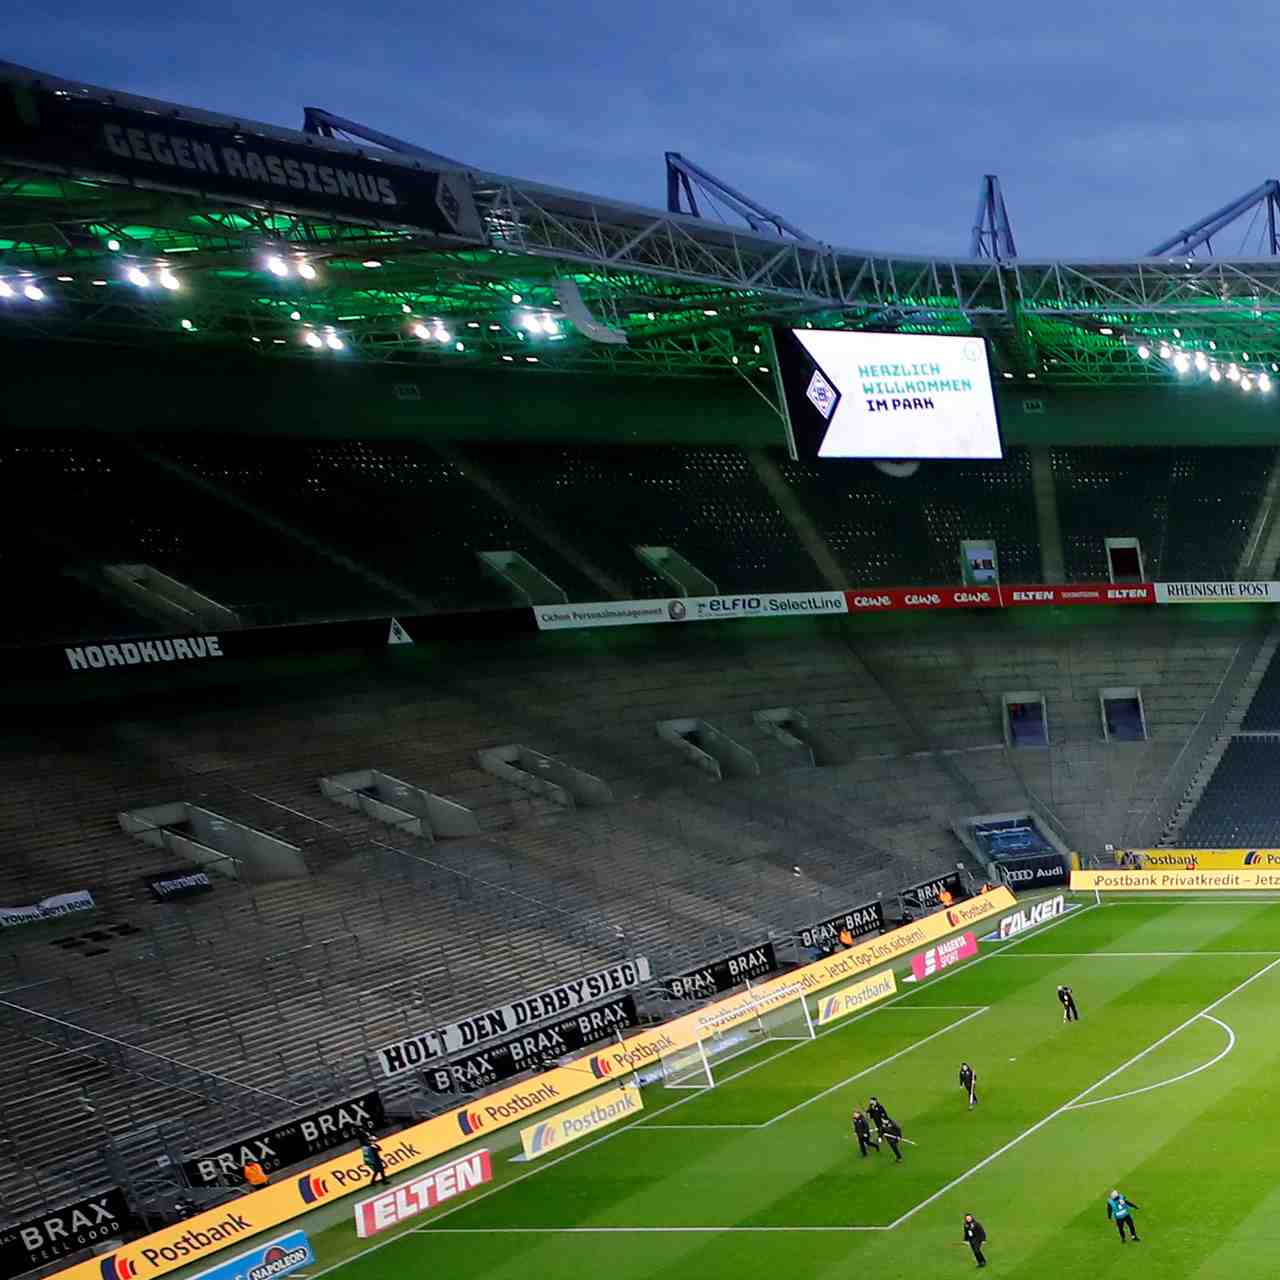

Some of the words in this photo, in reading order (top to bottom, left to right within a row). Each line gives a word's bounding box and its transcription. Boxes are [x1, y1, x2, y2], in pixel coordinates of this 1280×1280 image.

[103, 123, 219, 176] GEGEN
[222, 146, 397, 206] RASSISMUS
[857, 363, 941, 378] HERZLICH
[863, 379, 973, 394] WILLKOMMEN
[866, 398, 889, 412] IM
[892, 397, 935, 411] PARK
[769, 598, 842, 612] SelectLine
[854, 596, 892, 607] cewe
[904, 593, 941, 605] cewe
[954, 591, 991, 602] cewe
[1013, 590, 1054, 601] ELTEN
[1107, 588, 1147, 599] ELTEN
[1167, 583, 1238, 597] RHEINISCHE
[1239, 582, 1271, 596] POST
[64, 636, 224, 670] NORDKURVE
[1036, 866, 1064, 879] Audi
[1096, 875, 1158, 888] Postbank
[1161, 874, 1240, 887] Privatkredit
[846, 906, 879, 929] BRAX
[1000, 894, 1064, 938] FALKEN
[729, 948, 768, 976] BRAX
[672, 969, 716, 998] BRAX
[844, 976, 892, 1009] Postbank
[386, 1028, 448, 1073] HOLT
[461, 1009, 506, 1046] DEN
[514, 963, 635, 1027] DERBYSIEG
[579, 1001, 628, 1033] BRAX
[511, 1027, 566, 1061] BRAX
[614, 1033, 675, 1069] Postbank
[434, 1053, 495, 1091] BRAX
[486, 1083, 560, 1122] Postbank
[562, 1092, 636, 1136] Postbank
[301, 1101, 371, 1144] BRAX
[197, 1138, 278, 1182] BRAX
[331, 1141, 421, 1187] Posank
[373, 1154, 484, 1230] ELTEN
[19, 1198, 117, 1252] BRAX
[78, 1220, 122, 1246] GOOD
[142, 1212, 252, 1269] Postbank
